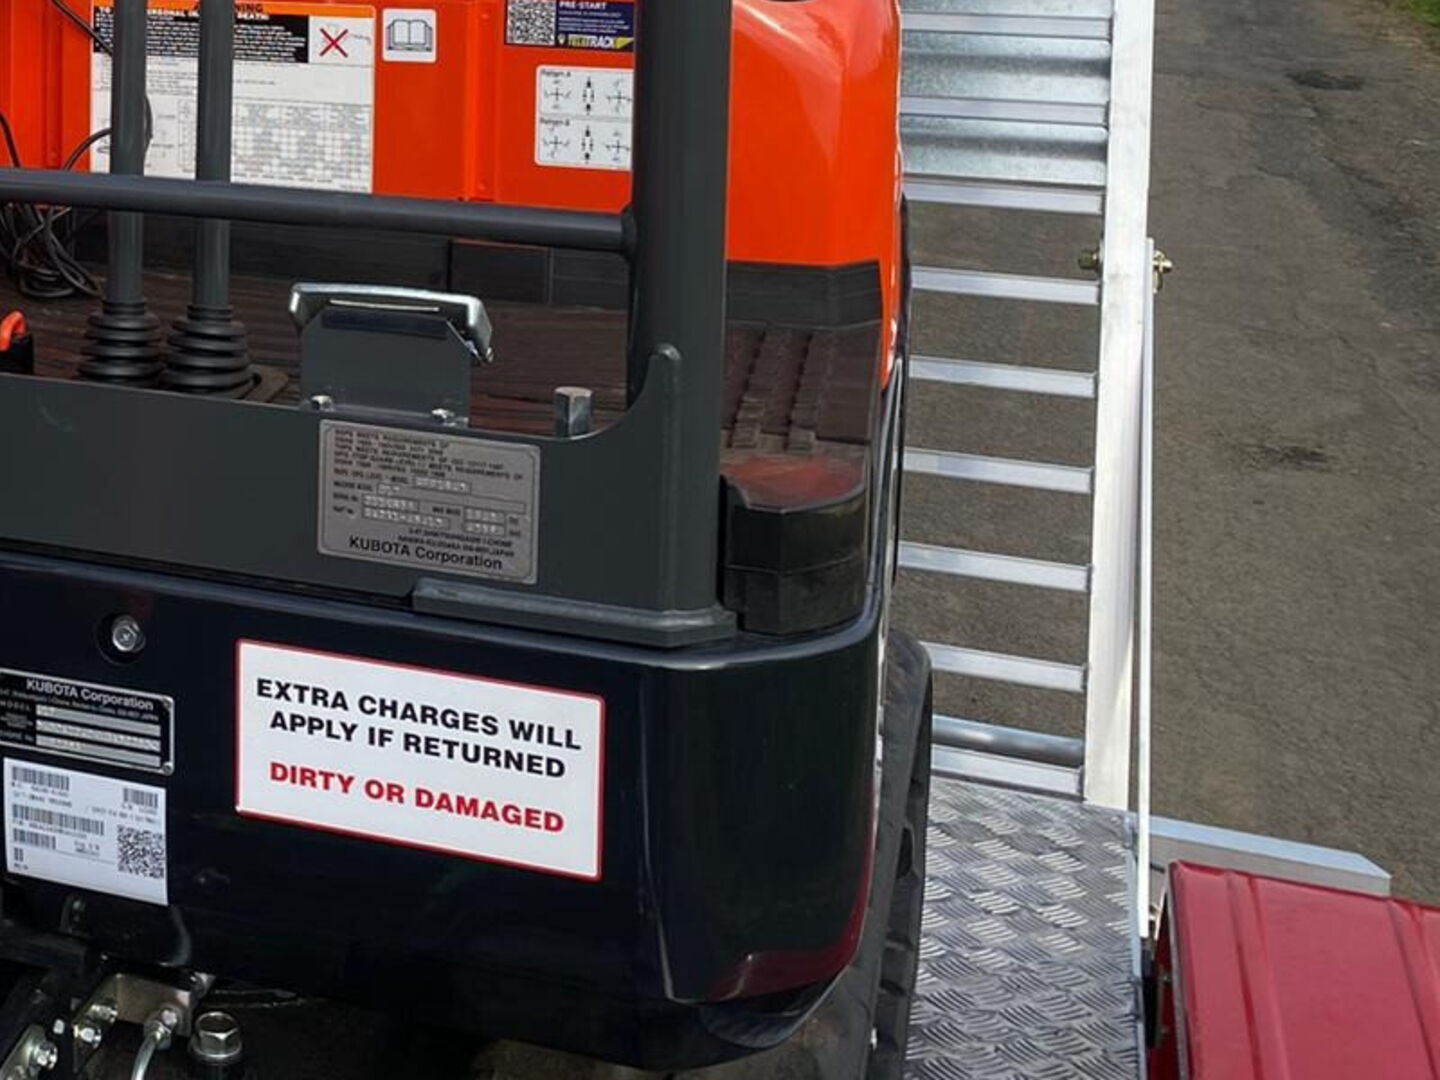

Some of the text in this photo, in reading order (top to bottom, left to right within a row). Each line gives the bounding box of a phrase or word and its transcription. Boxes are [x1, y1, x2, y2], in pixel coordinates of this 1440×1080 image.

[349, 535, 410, 556] KUBOTA
[415, 546, 503, 570] Corporation
[26, 677, 78, 699] KUBOTA
[80, 688, 154, 711] Corporation
[256, 678, 582, 750] EXTRA CHARGES WILL
[270, 711, 566, 779] APPLY IF RETURNED
[269, 762, 565, 833] DIRTY OR DAMAGED
